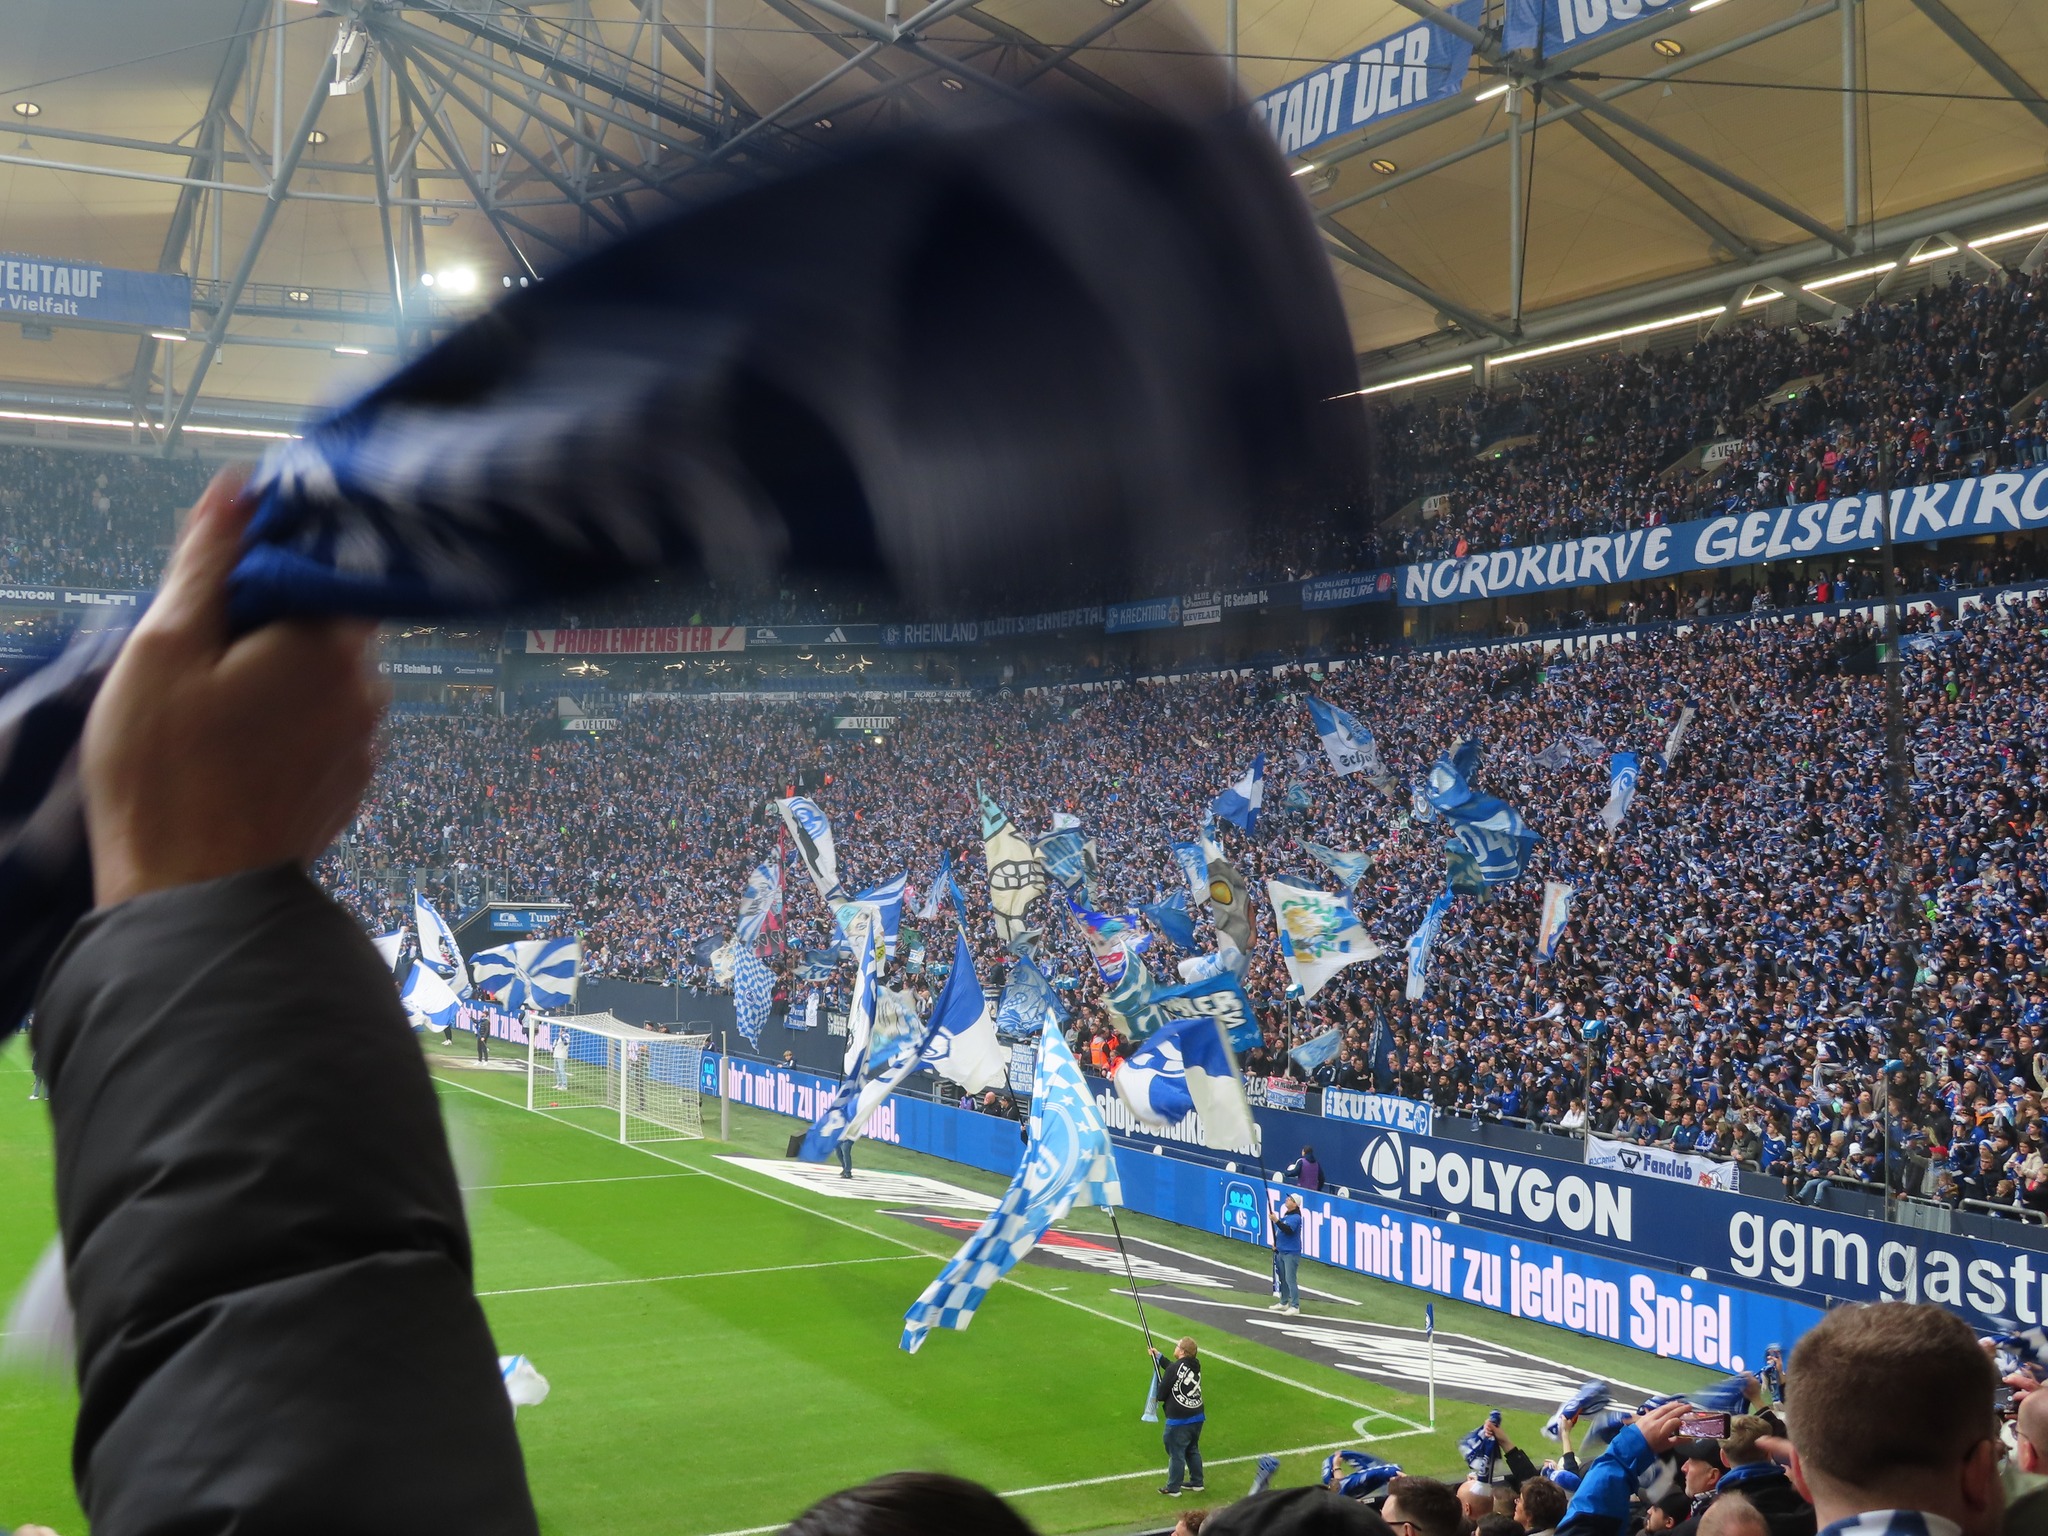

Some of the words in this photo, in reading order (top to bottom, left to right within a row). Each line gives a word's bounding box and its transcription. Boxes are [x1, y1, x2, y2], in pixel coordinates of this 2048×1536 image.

[1352, 26, 1430, 124] DER
[9, 293, 78, 316] Vielfalt
[1405, 527, 1671, 602] NORDKURVE
[1314, 578, 1349, 588] SCHALKER
[1349, 574, 1377, 585] FILIALE
[0, 589, 55, 601] POLYGON
[65, 592, 136, 606] HILTI
[1224, 595, 1231, 608] FC
[1233, 592, 1258, 607] Schalke
[1259, 590, 1268, 603] 04
[1314, 583, 1374, 602] HAMBURG
[1036, 606, 1105, 631] ENNEPETAL
[1120, 604, 1167, 625] KRECHTING
[1184, 609, 1221, 622] KEVELAER
[553, 627, 713, 653] PROBLEMFENSTER
[904, 622, 978, 643] RHEINLAND
[393, 663, 402, 673] FC
[404, 664, 431, 674] Schalke
[432, 665, 442, 674] 04
[914, 690, 937, 698] NORD
[582, 719, 615, 730] VELTIN
[856, 717, 893, 729] VELTIN
[528, 912, 557, 923] Tunn
[755, 1069, 775, 1110] mit
[777, 1072, 795, 1115] Dir
[798, 1085, 813, 1120] zu
[1332, 1092, 1415, 1131] KURVE
[1643, 1154, 1692, 1180] Fanclub
[1410, 1146, 1633, 1243] POLYGON
[1354, 1213, 1403, 1282] mit
[1411, 1221, 1456, 1294] Dir
[1462, 1246, 1501, 1307] zu
[1510, 1244, 1619, 1340] jedem
[1629, 1273, 1745, 1373] Spiel.
